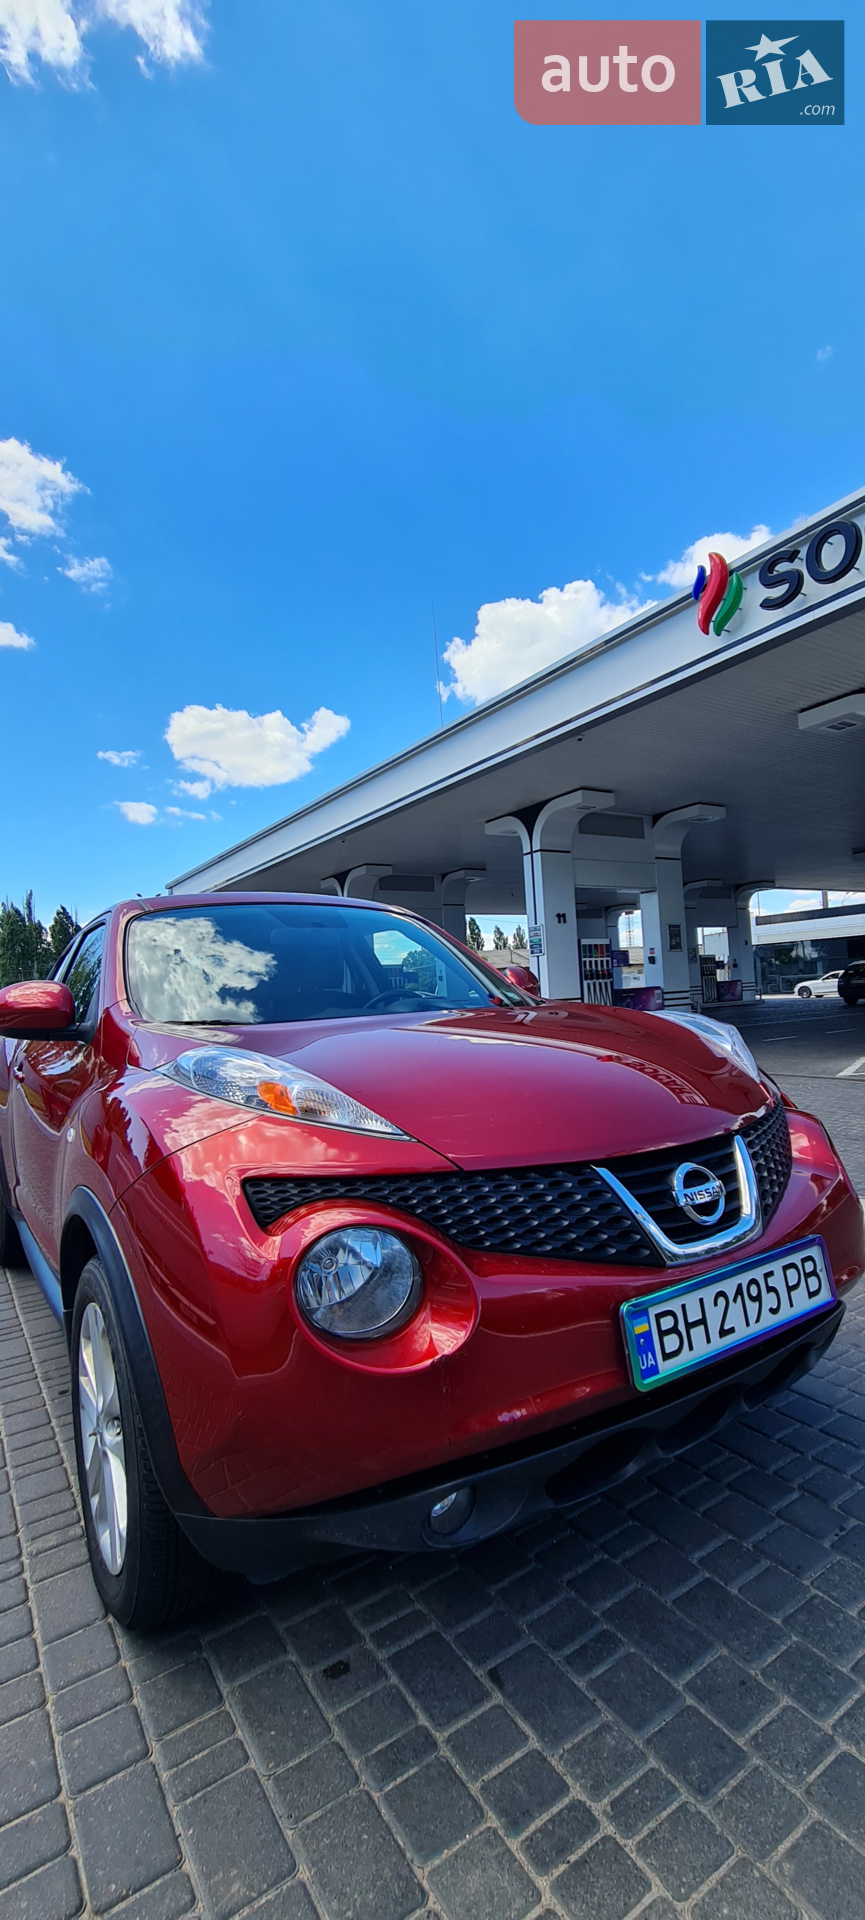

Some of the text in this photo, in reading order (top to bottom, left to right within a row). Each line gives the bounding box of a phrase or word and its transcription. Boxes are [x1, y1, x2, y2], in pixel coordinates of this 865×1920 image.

[555, 912, 566, 924] 11
[683, 1184, 724, 1205] NISSAN
[639, 1353, 656, 1370] UA
